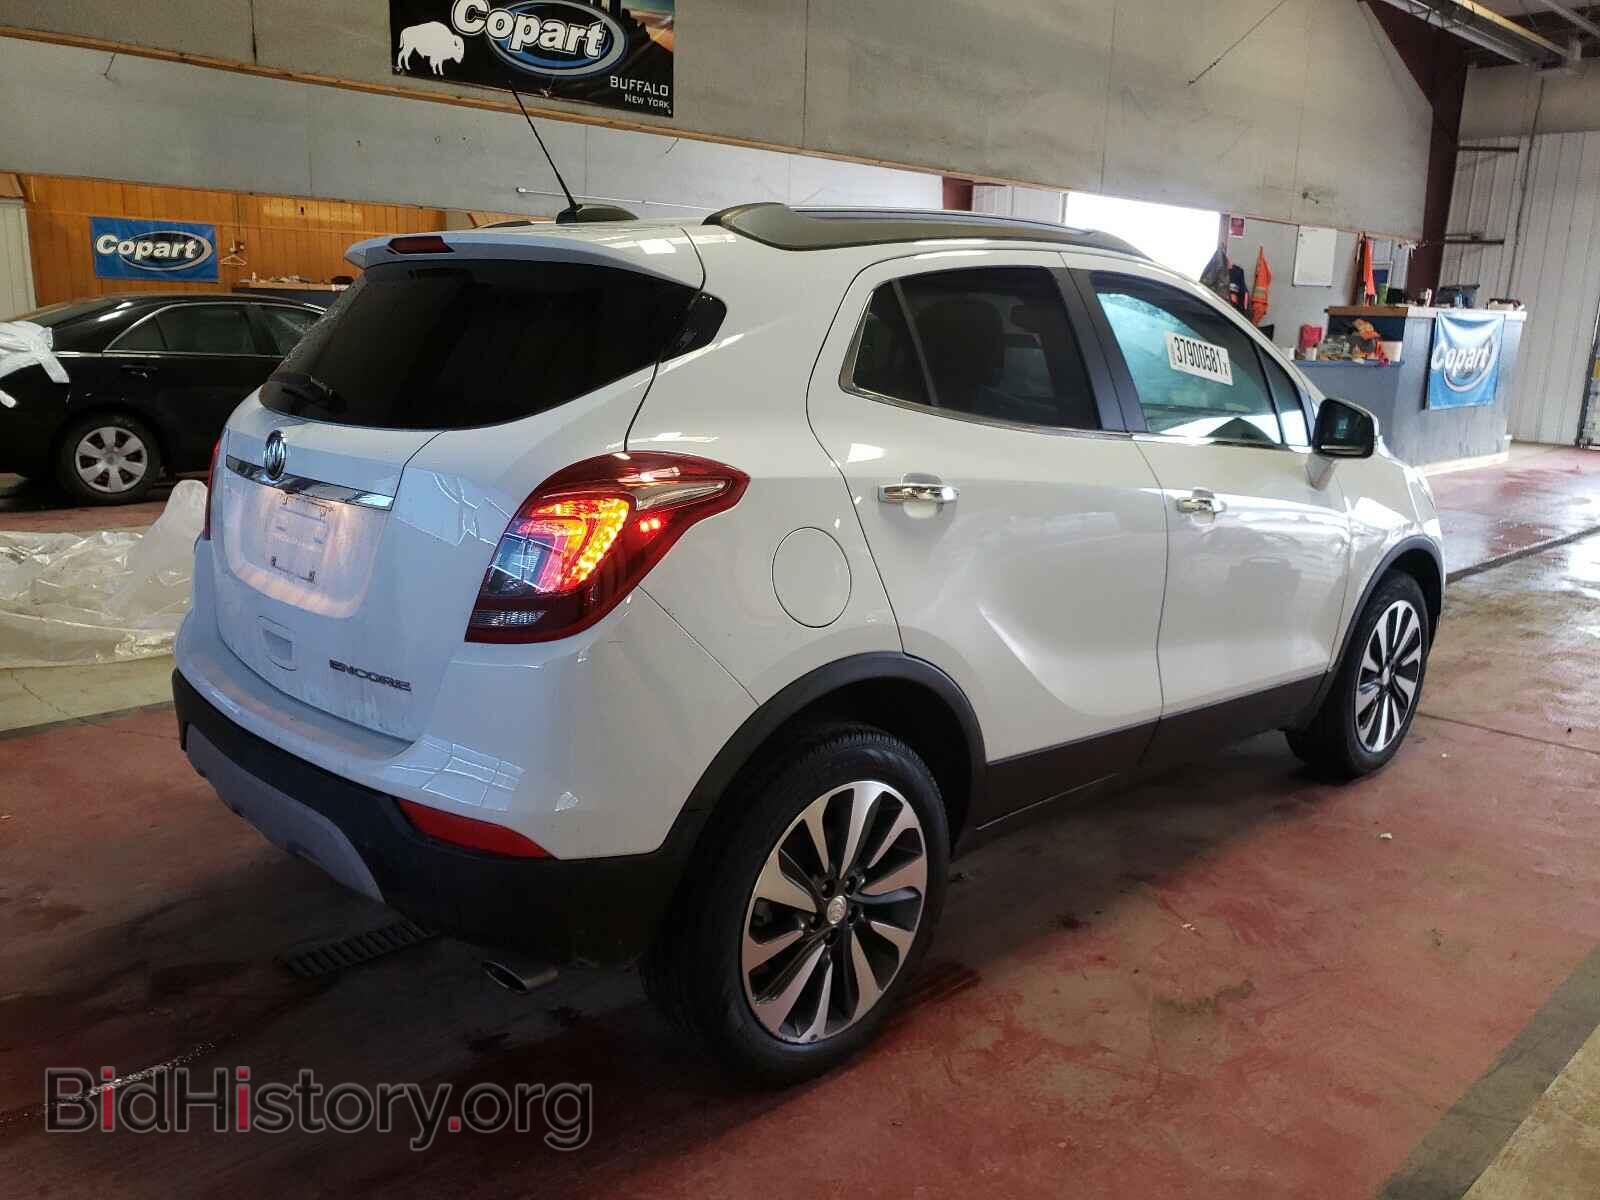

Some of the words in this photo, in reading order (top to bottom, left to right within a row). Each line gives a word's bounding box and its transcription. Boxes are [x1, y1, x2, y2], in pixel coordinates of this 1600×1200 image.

[452, 0, 605, 57] Copart
[609, 75, 669, 97] BUFFALO
[96, 234, 197, 261] Copart
[1431, 340, 1489, 377] Copart
[329, 659, 411, 692] ENCORE
